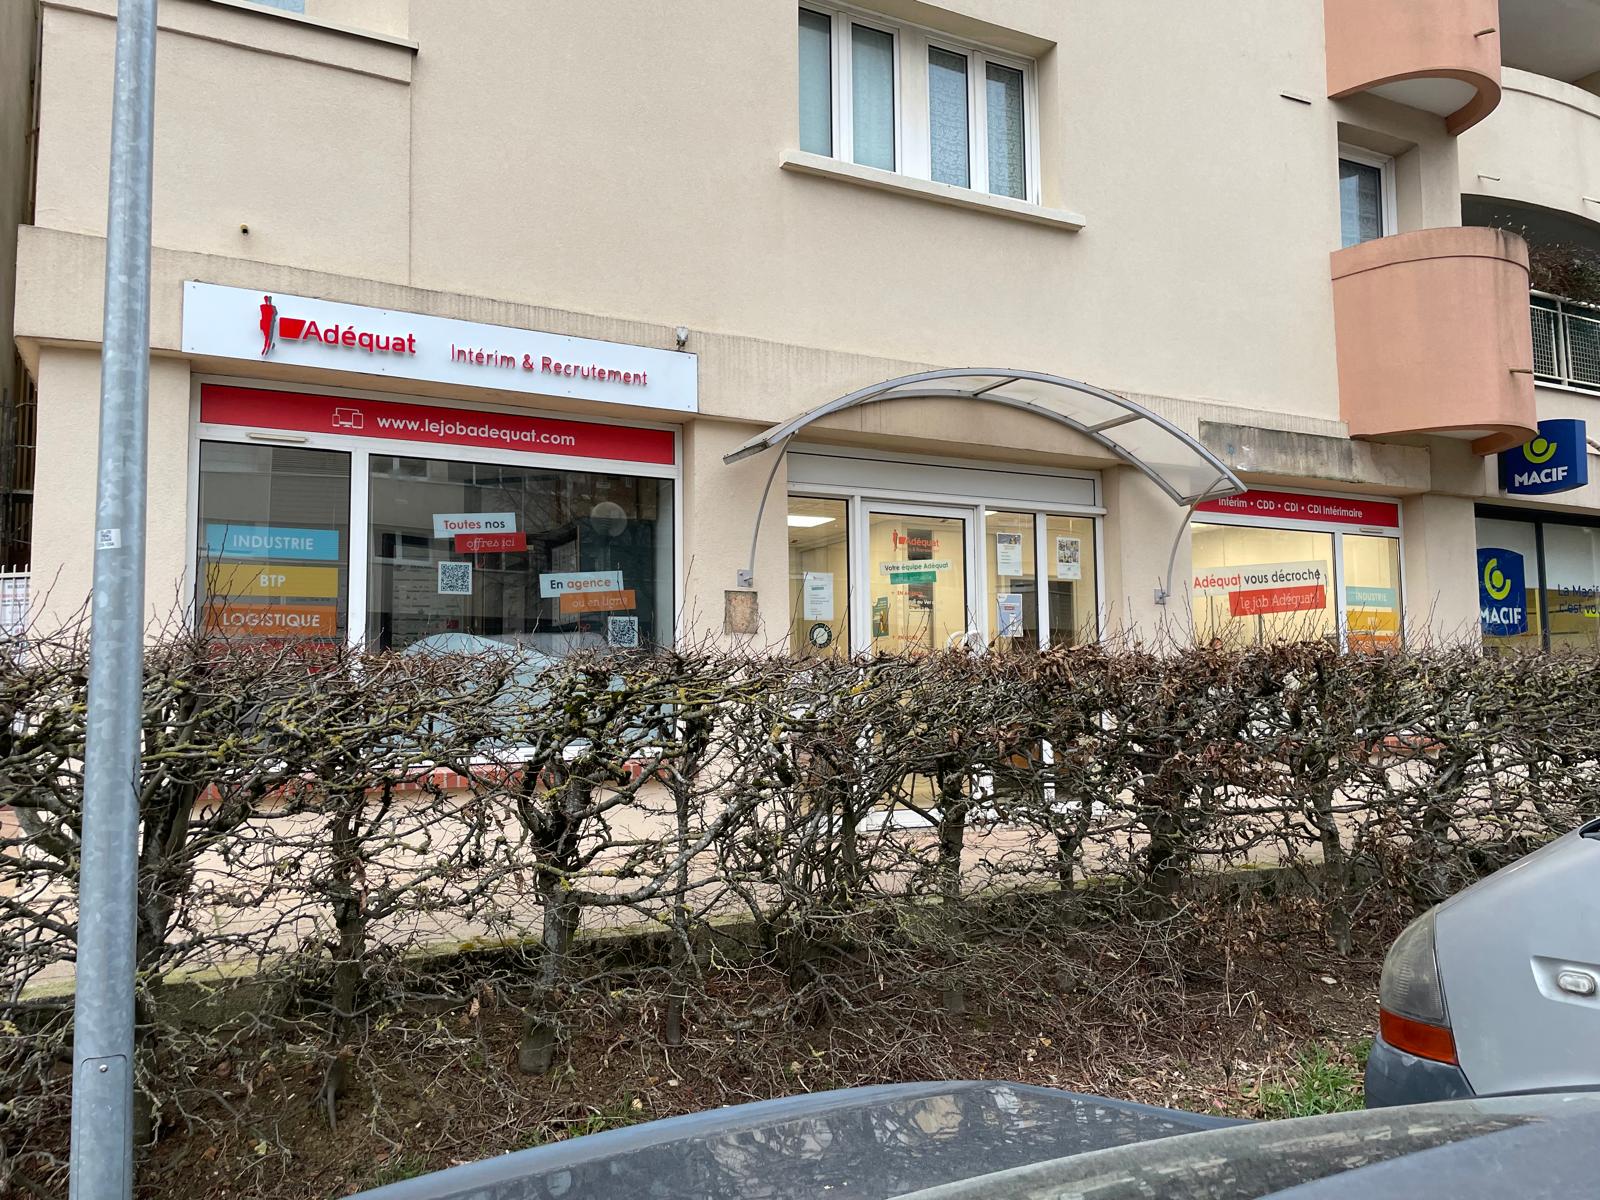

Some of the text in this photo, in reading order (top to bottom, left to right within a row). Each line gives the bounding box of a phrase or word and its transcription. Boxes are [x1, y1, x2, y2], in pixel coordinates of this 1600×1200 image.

[302, 320, 416, 354] Adéquat
[450, 343, 648, 385] Intérim & Recrutement
[376, 416, 576, 446] www.lejobadequat.com
[1514, 465, 1568, 487] MACIF
[1218, 497, 1363, 518] Intérim CDD CDI CDI Intérimaire
[443, 519, 506, 530] Toutes nos
[232, 534, 315, 550] INDUSTRIE
[466, 537, 515, 551] offres ici
[905, 537, 940, 549] Adéquat
[884, 564, 901, 572] Votre
[901, 563, 923, 571] équipe
[259, 574, 286, 588] BTP
[550, 578, 612, 591] En agence
[1193, 568, 1320, 590] Adéquat vous décroche
[1557, 583, 1570, 597] La
[1252, 597, 1269, 612] job
[1271, 592, 1314, 608] Adéquat
[222, 613, 320, 627] LOGISTIQUE
[1480, 607, 1522, 624] MACIF
